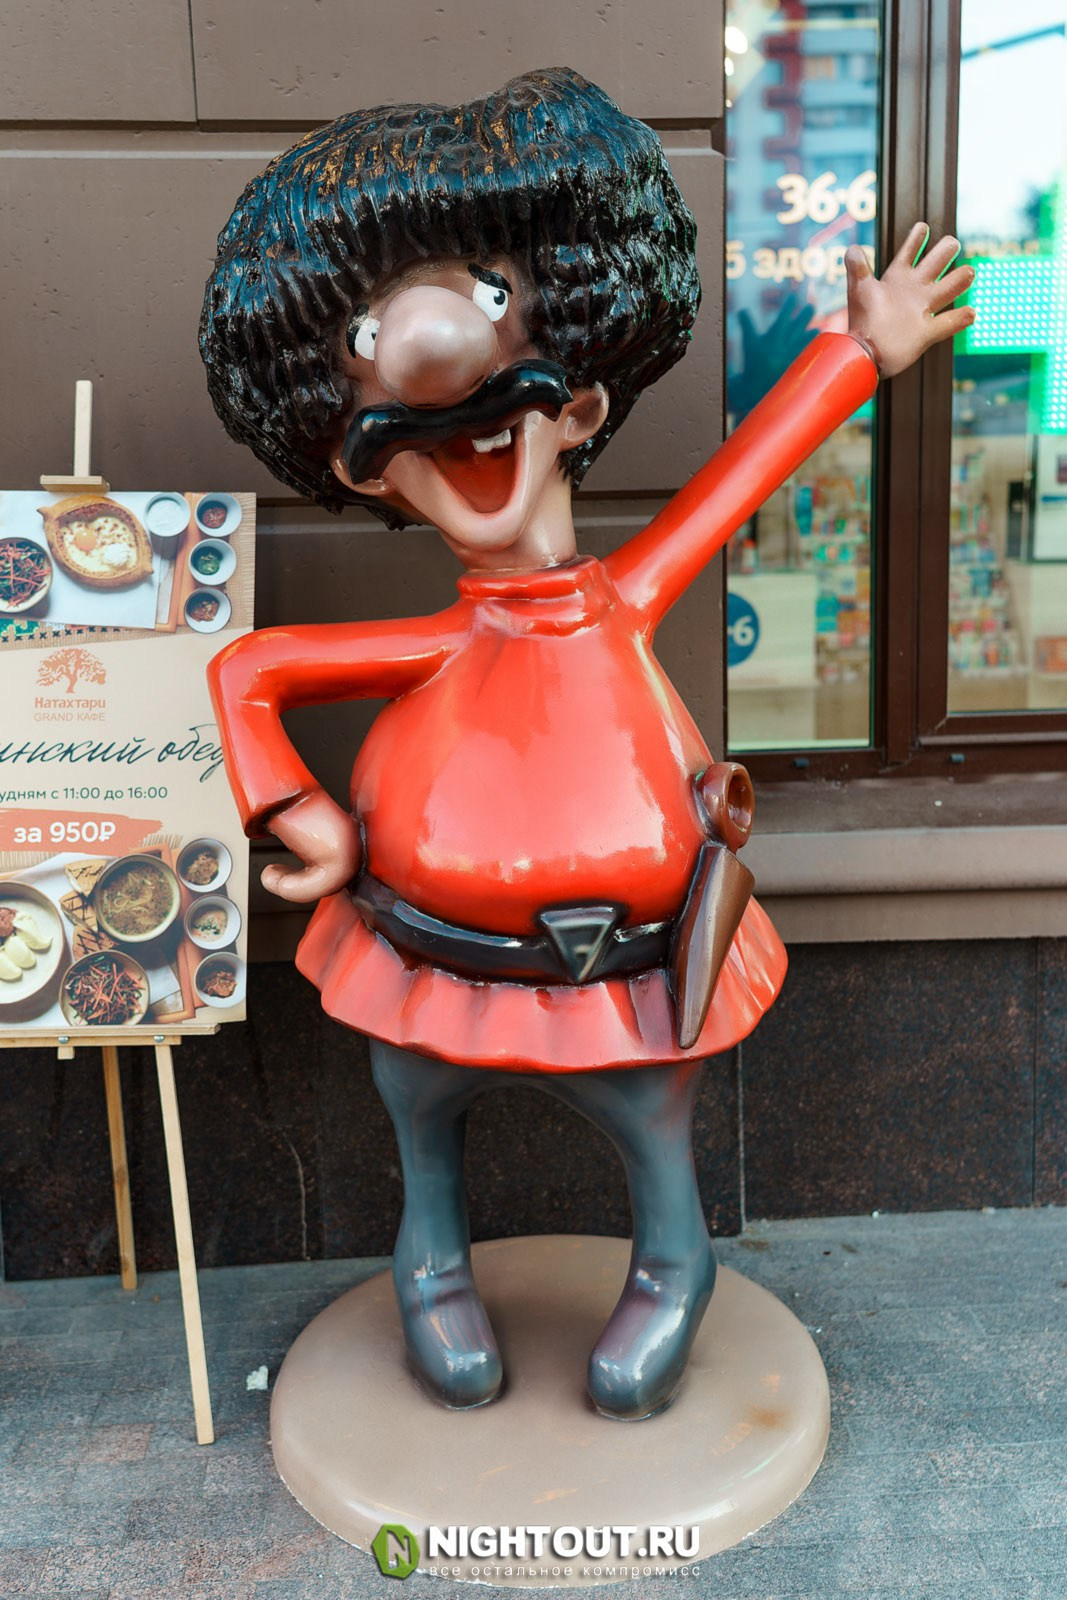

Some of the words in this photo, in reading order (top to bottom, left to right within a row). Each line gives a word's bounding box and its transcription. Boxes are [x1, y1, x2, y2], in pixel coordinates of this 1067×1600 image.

[752, 246, 876, 284] здор
[34, 697, 106, 711] Натахтари
[34, 712, 74, 722] GRAND
[77, 712, 106, 722] КАФЕ
[50, 790, 59, 799] с
[63, 787, 100, 799] 11:00
[104, 789, 124, 801] до
[127, 786, 168, 799] 16:00
[13, 826, 42, 843] за
[49, 821, 116, 843] 950₽
